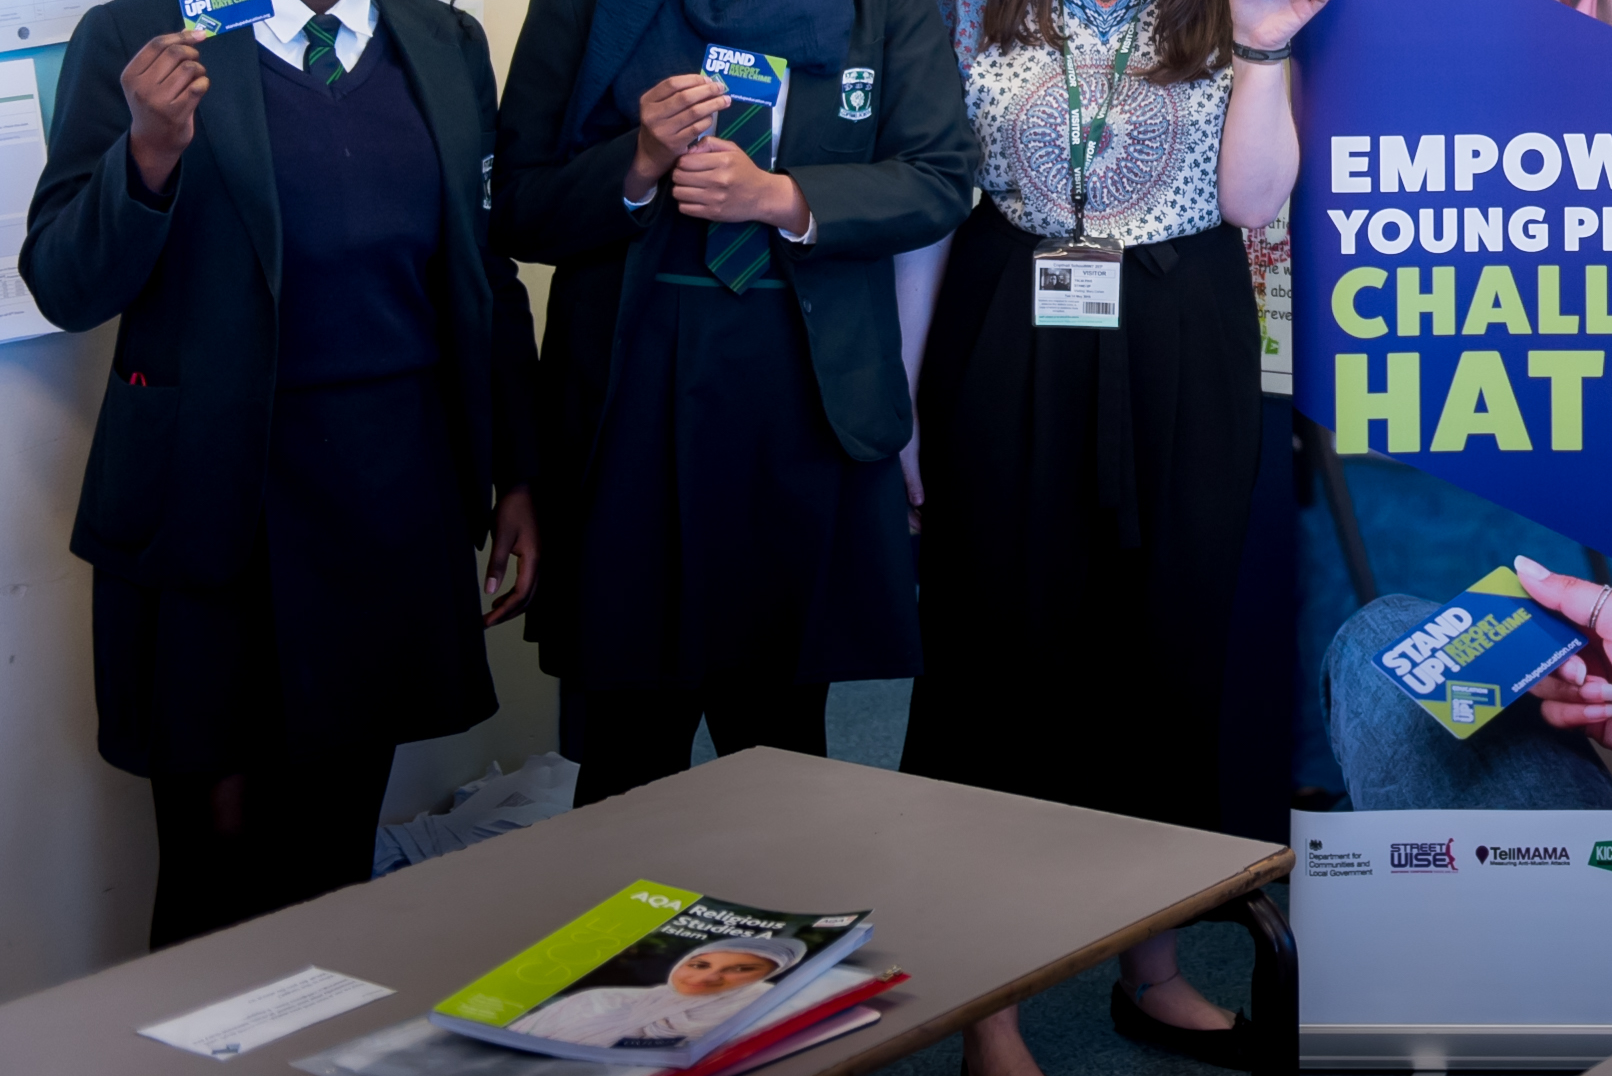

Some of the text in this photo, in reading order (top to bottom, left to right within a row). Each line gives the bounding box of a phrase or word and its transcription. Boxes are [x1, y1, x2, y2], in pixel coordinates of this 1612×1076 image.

[1120, 20, 1137, 54] VISITOR
[705, 58, 731, 75] UP!
[707, 46, 756, 67] STAND
[1065, 53, 1078, 88] VISITOR
[1070, 108, 1081, 146] VISITOR
[1327, 204, 1549, 255] YOUNG
[1381, 606, 1473, 677] STAND
[1444, 613, 1502, 657] REPORT
[1451, 606, 1533, 668] HATE CRIME
[1401, 649, 1461, 695] UP!
[1510, 637, 1583, 696] standupeducation.org
[1308, 852, 1363, 862] Department for
[1389, 843, 1446, 853] STREET
[1389, 852, 1449, 869] WISE
[1490, 846, 1571, 861] TellMAMA
[1308, 860, 1371, 871] Communities and
[1308, 867, 1374, 877] Local Government
[1489, 860, 1518, 868] Measuring
[630, 890, 684, 914] AQA
[671, 914, 773, 941] Studies A
[688, 904, 788, 932] Religious
[659, 924, 708, 943] Islam
[515, 916, 643, 985] GCSE
